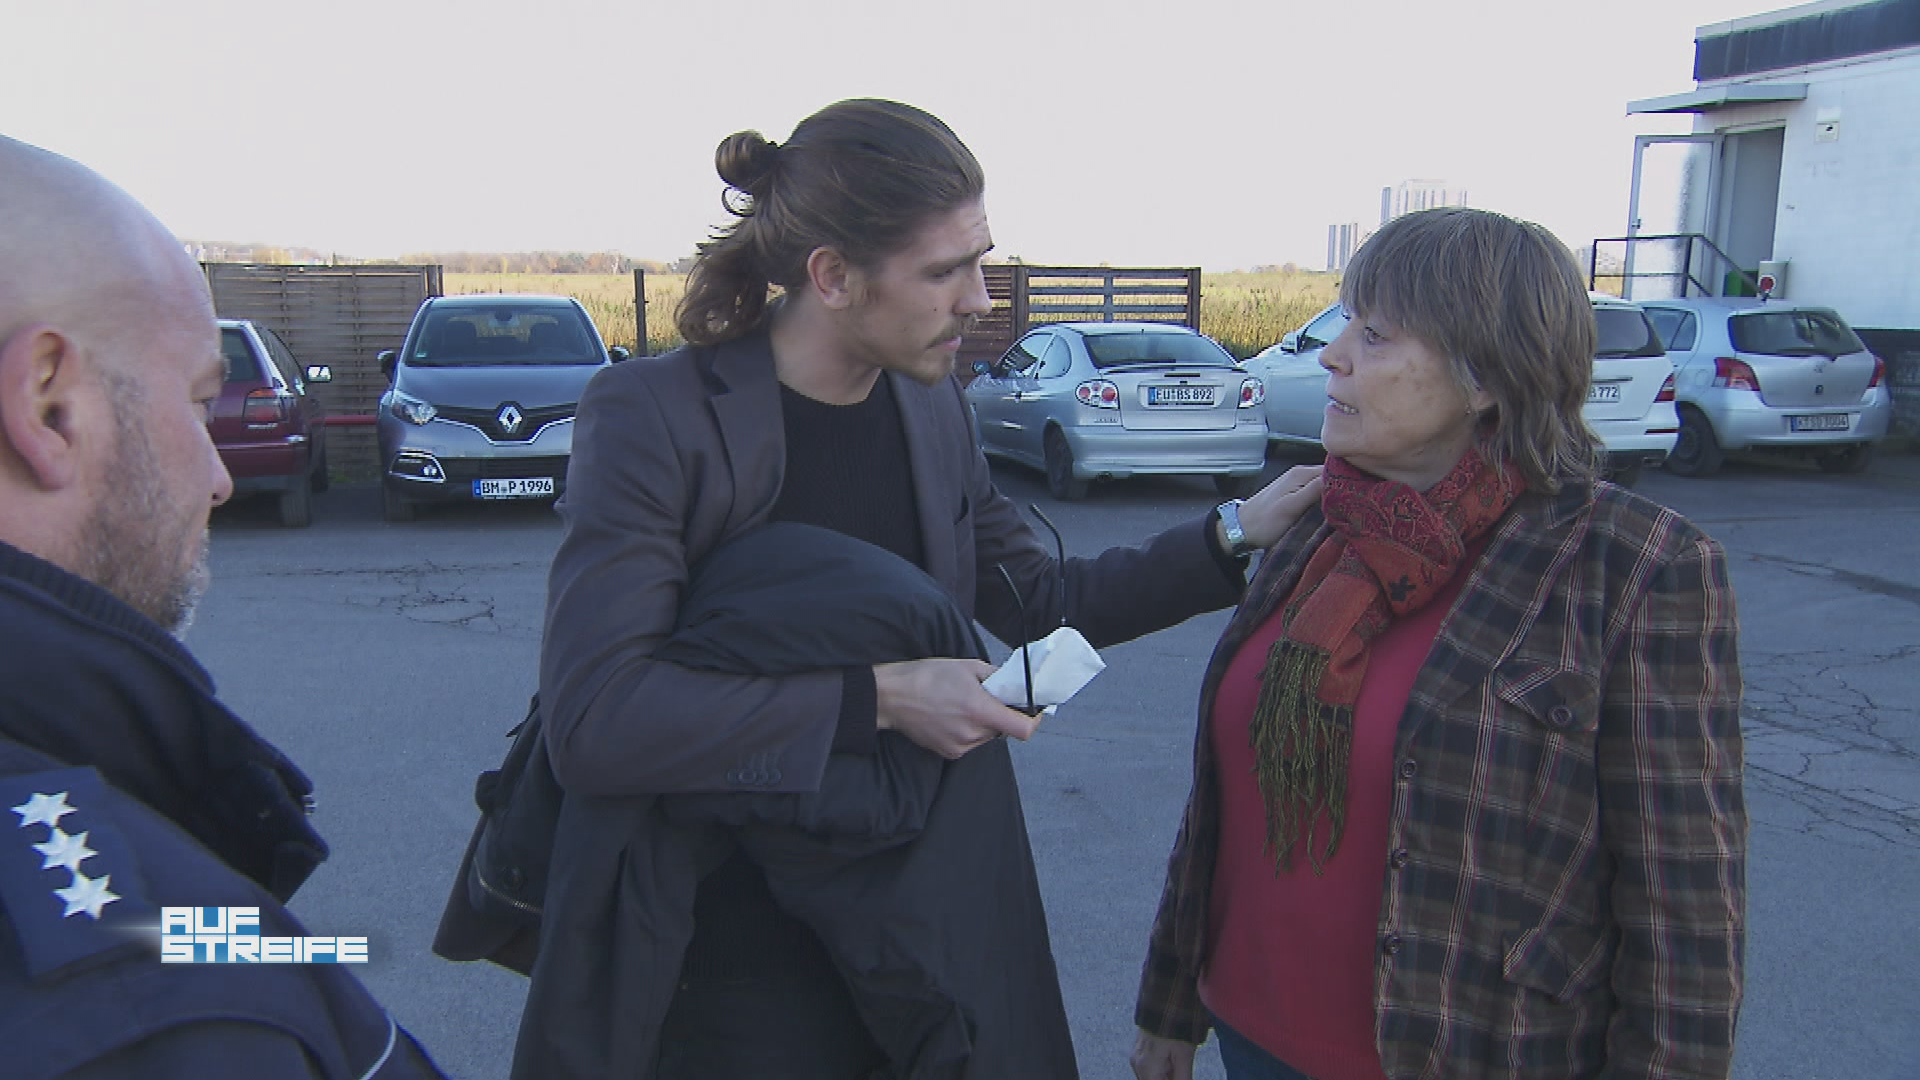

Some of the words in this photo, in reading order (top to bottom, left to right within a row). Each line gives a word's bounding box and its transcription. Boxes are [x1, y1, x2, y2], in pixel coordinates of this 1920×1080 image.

[1192, 389, 1213, 400] 892
[1598, 386, 1618, 398] 772
[481, 482, 500, 494] BM
[508, 480, 517, 494] P
[519, 480, 552, 492] 1996
